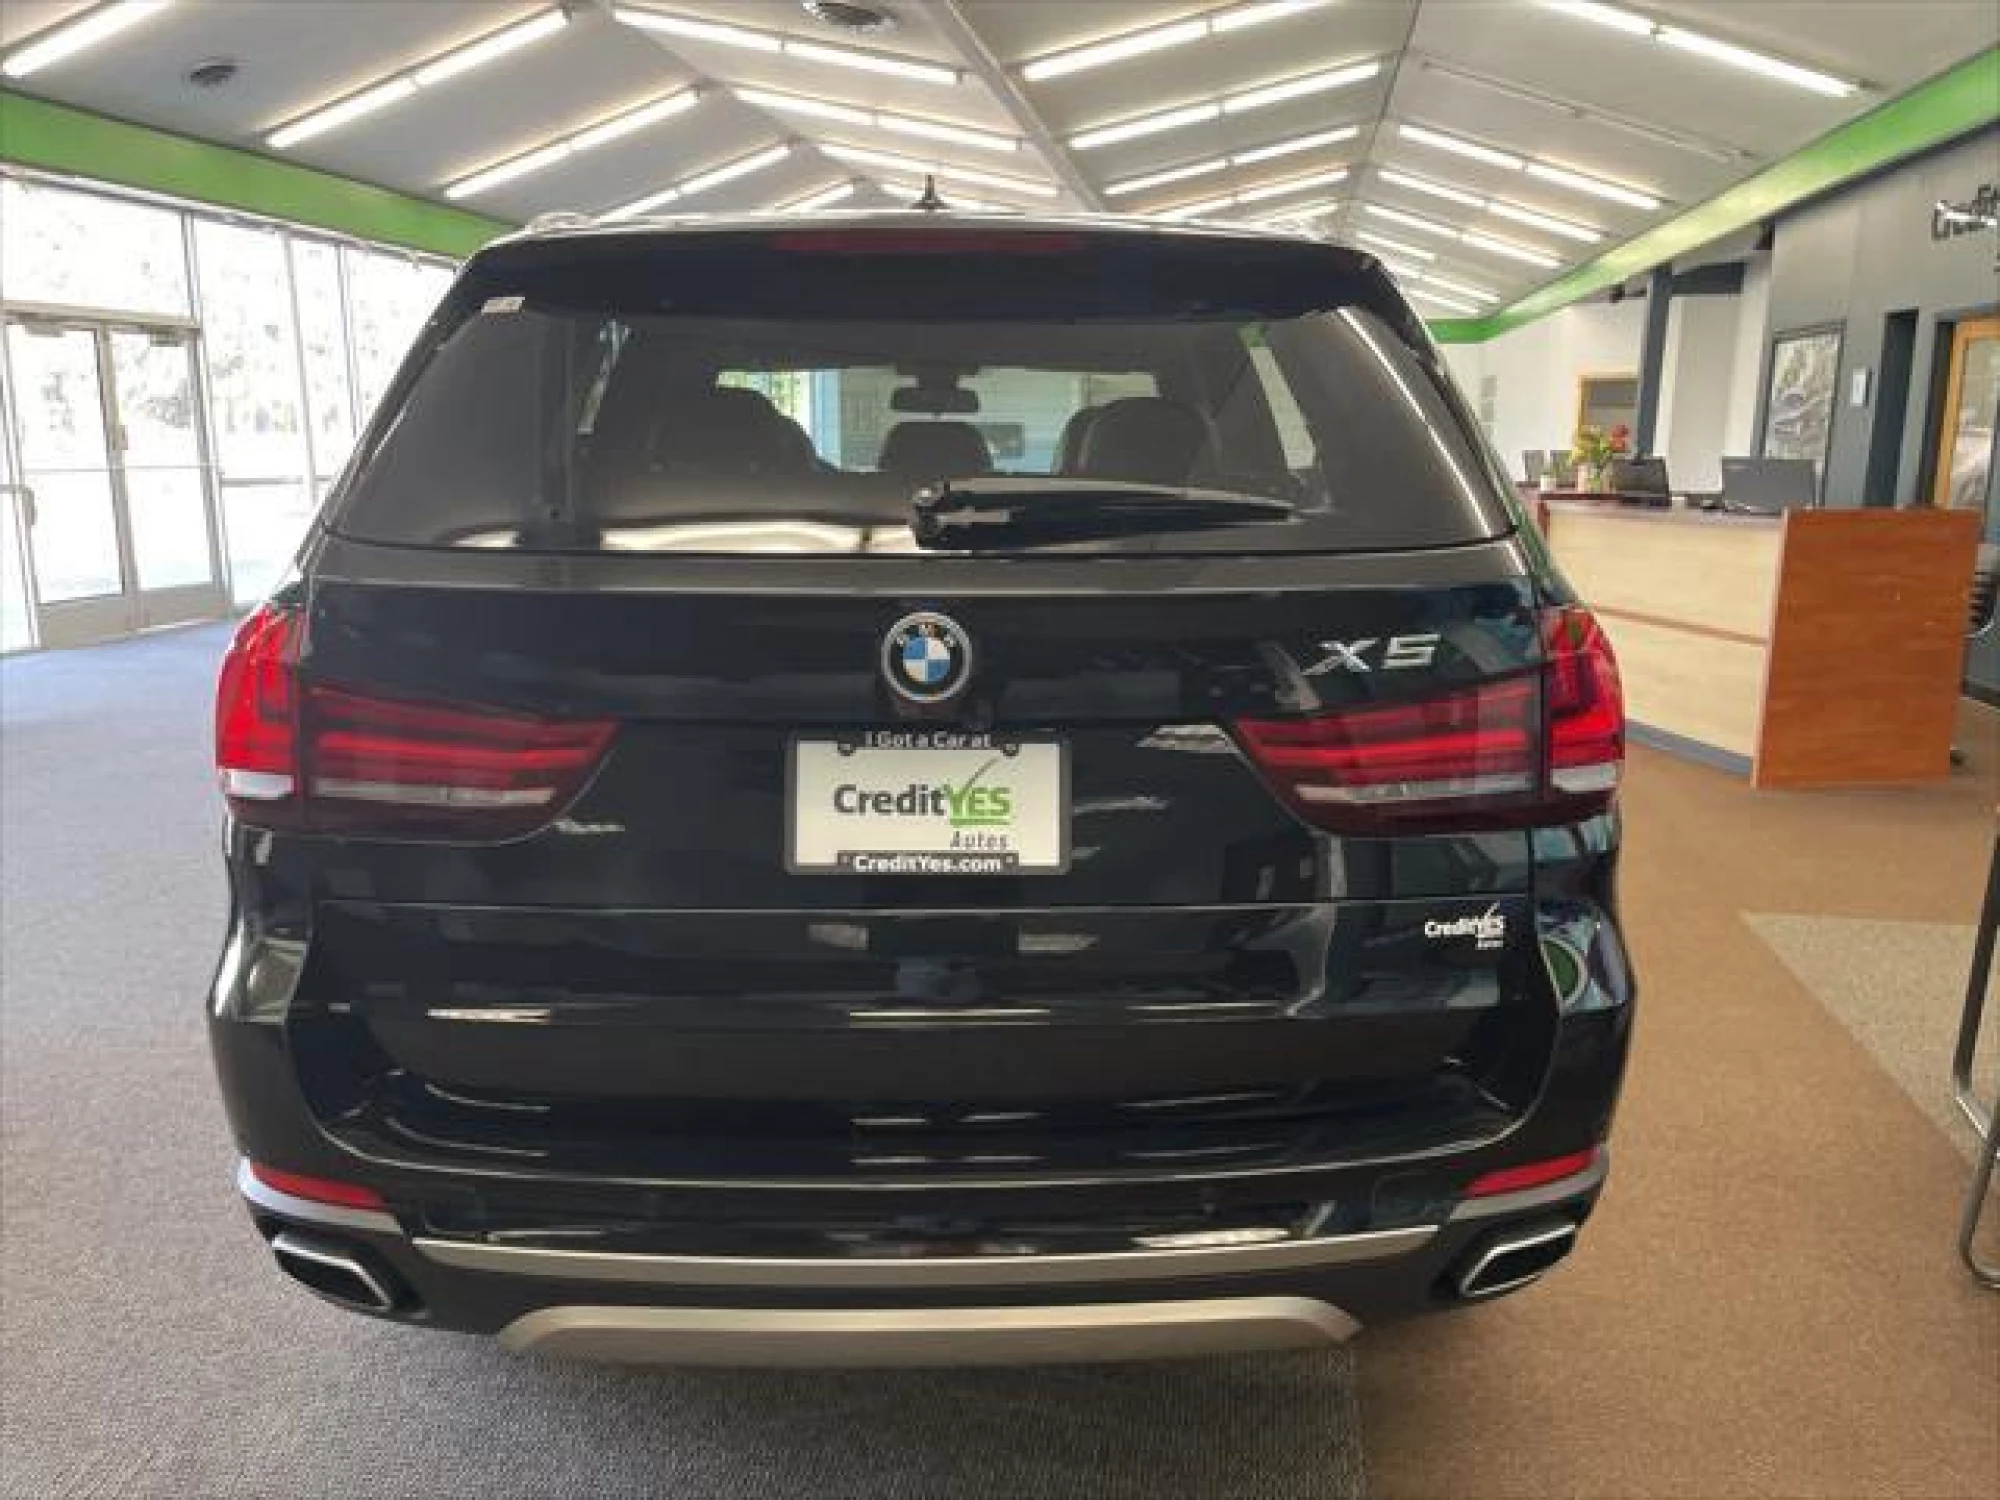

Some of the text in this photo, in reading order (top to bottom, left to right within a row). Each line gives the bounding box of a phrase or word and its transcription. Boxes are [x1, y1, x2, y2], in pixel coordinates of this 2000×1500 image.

[1301, 633, 1441, 675] X5
[833, 783, 1011, 817] CreditYES
[854, 854, 1002, 873] CreditYes.com
